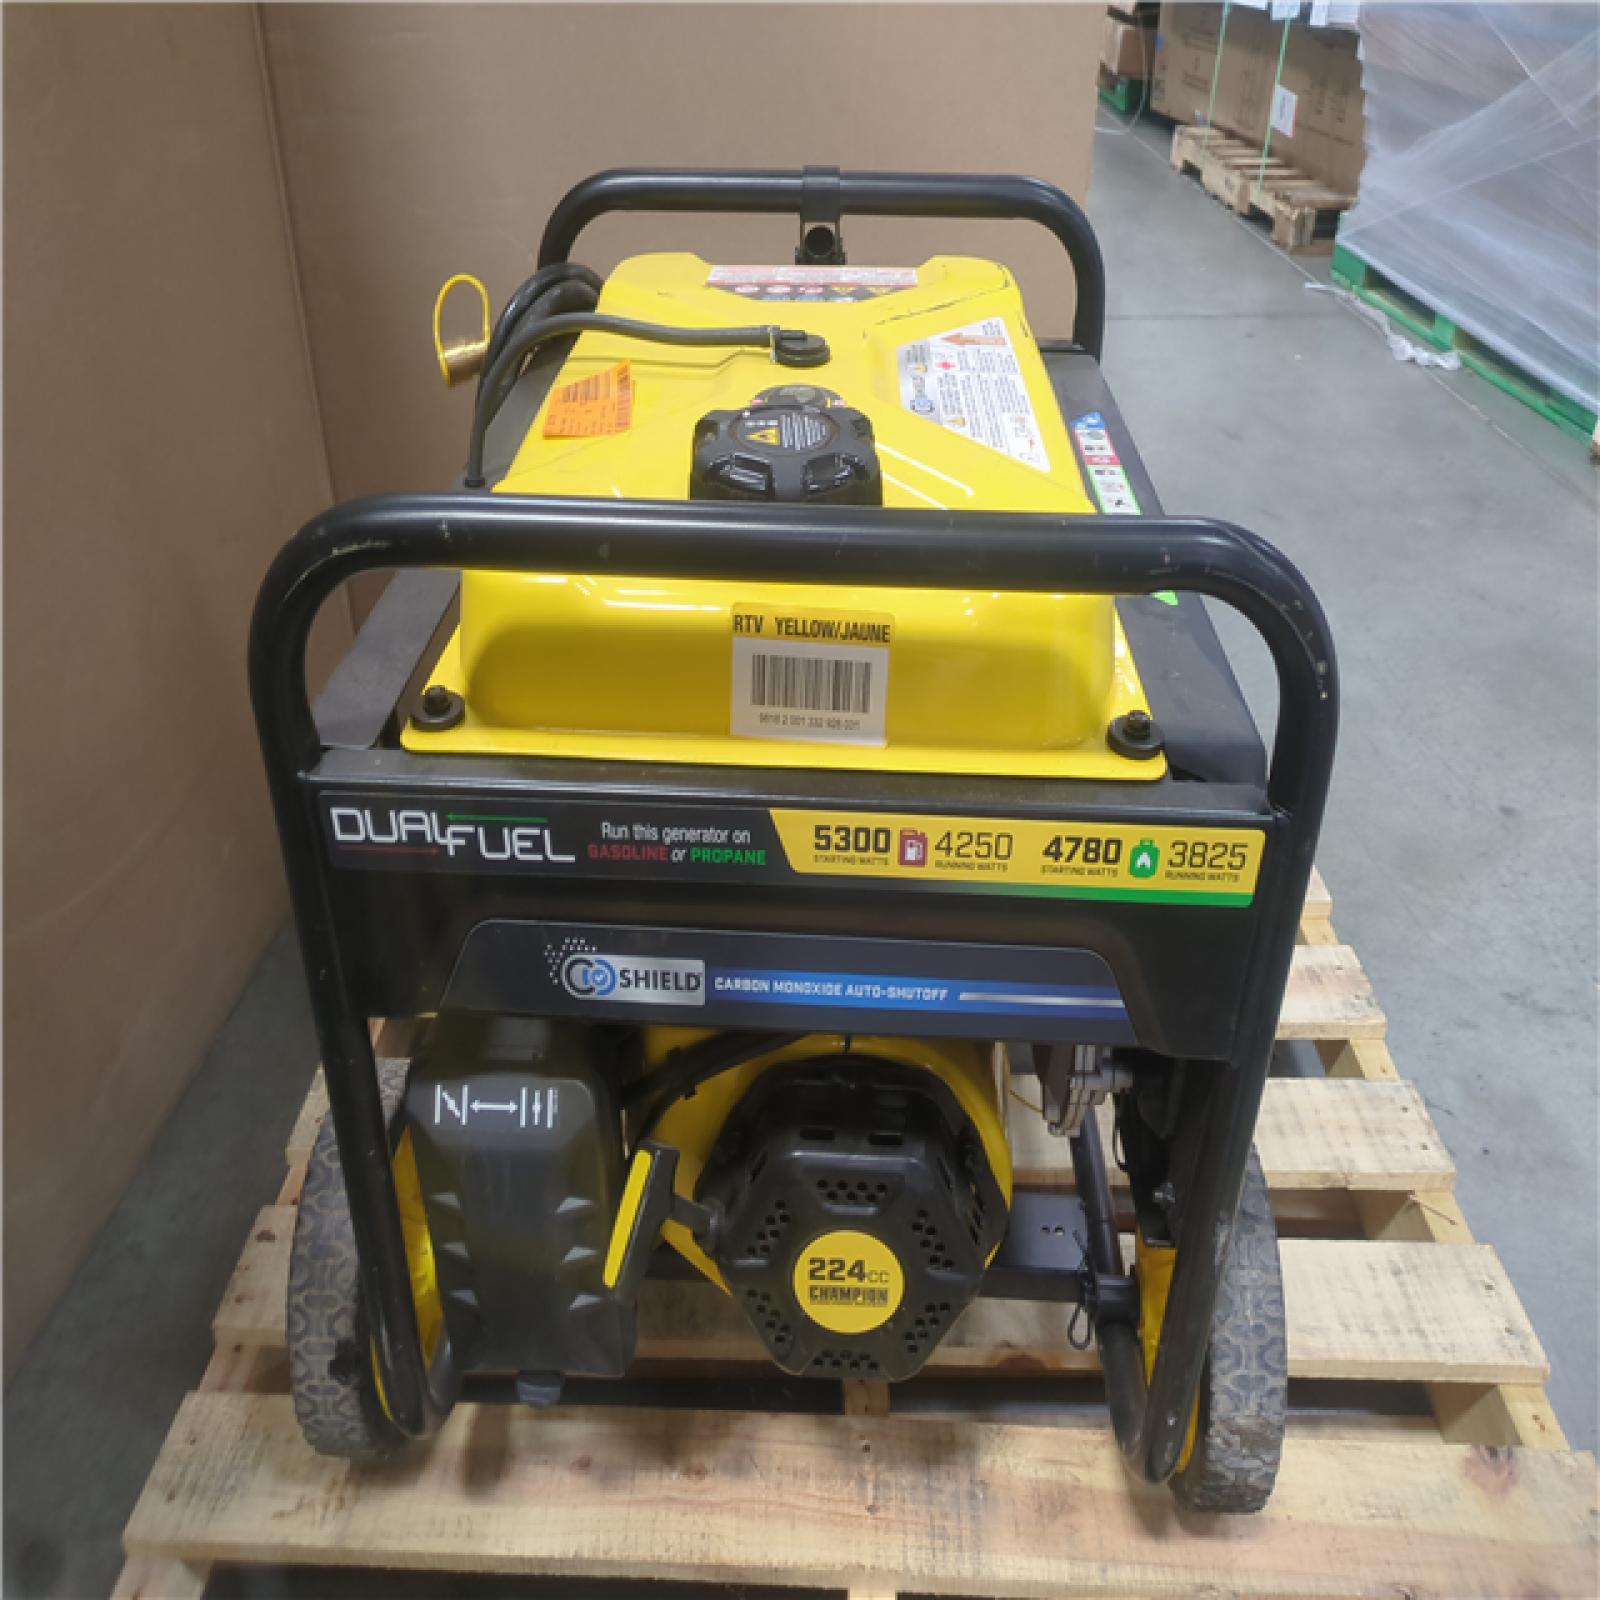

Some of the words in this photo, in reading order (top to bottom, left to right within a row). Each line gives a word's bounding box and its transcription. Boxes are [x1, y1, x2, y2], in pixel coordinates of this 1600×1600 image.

[733, 614, 764, 633] RTV
[774, 616, 891, 643] YELLOW/JAUNE
[330, 807, 450, 843] DUAL
[446, 824, 576, 863] FUEL
[602, 822, 629, 840] Run
[632, 823, 658, 840] this
[662, 826, 729, 845] generator
[732, 829, 751, 843] on
[587, 844, 669, 861] GASOLINE
[670, 848, 687, 862] or
[690, 847, 766, 865] PROPANE
[814, 825, 891, 853] 5300
[934, 830, 1014, 861] 4250
[1042, 835, 1123, 864] 4780
[1168, 840, 1249, 870] 3825
[814, 854, 856, 865] STARTING
[859, 856, 889, 866] WATTS
[935, 860, 975, 870] RUNNING
[977, 862, 1008, 872] WATTS
[1040, 865, 1085, 875] STARTING
[1087, 866, 1119, 877] WATTS
[1165, 870, 1205, 880] RUNNING
[1207, 872, 1240, 882] WATTS
[619, 967, 701, 991] SHIELD
[714, 976, 770, 992] CARBON
[772, 979, 841, 996] MONOXIDE
[845, 984, 949, 1000] AUTO-SHUTOFF
[809, 1286, 888, 1303] CHAMPION
